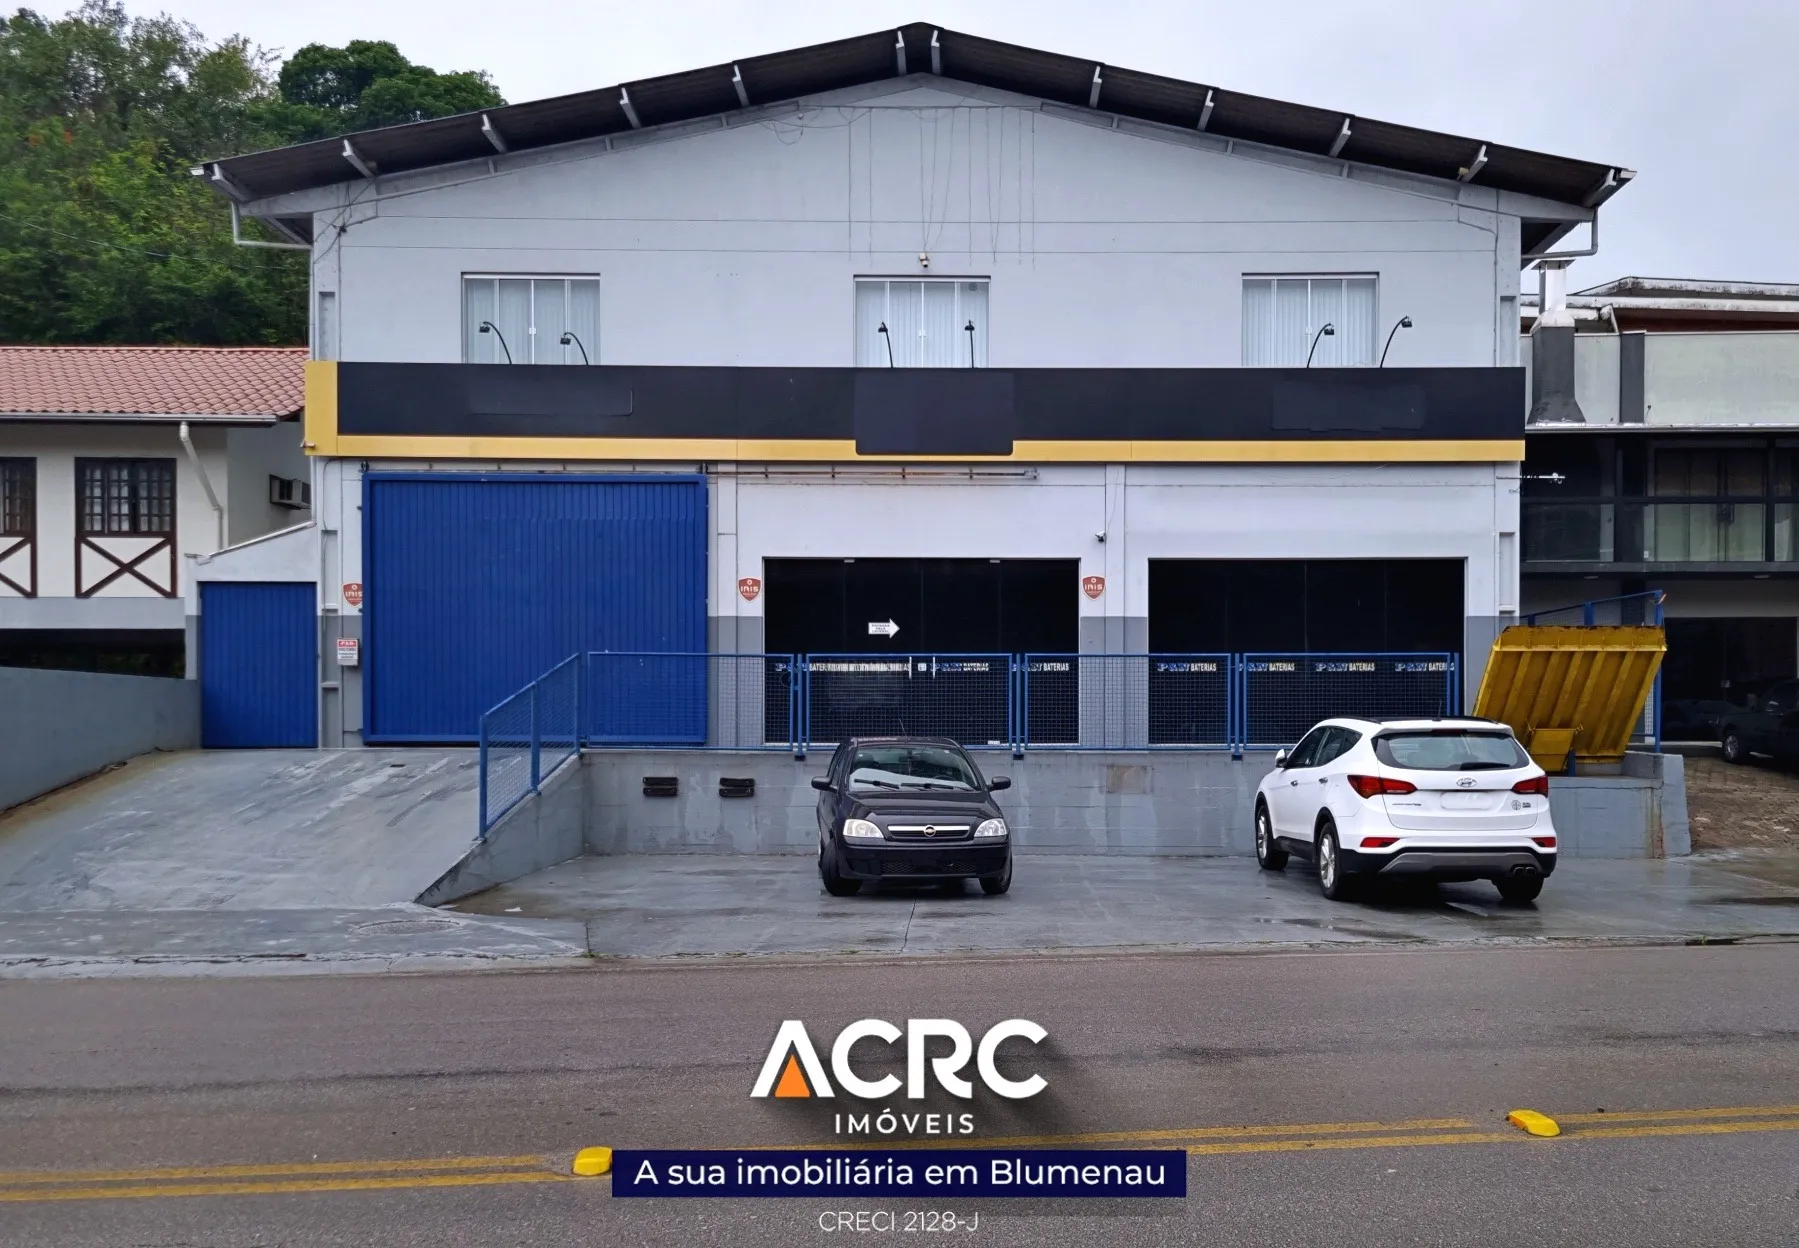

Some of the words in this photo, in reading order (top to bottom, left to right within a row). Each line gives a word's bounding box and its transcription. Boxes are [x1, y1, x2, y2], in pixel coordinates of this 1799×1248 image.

[1043, 663, 1069, 671] BATERIAS
[1190, 663, 1217, 671] BATERIAS
[1269, 663, 1295, 671] BATERIAS
[1349, 663, 1375, 671] BATERIAS
